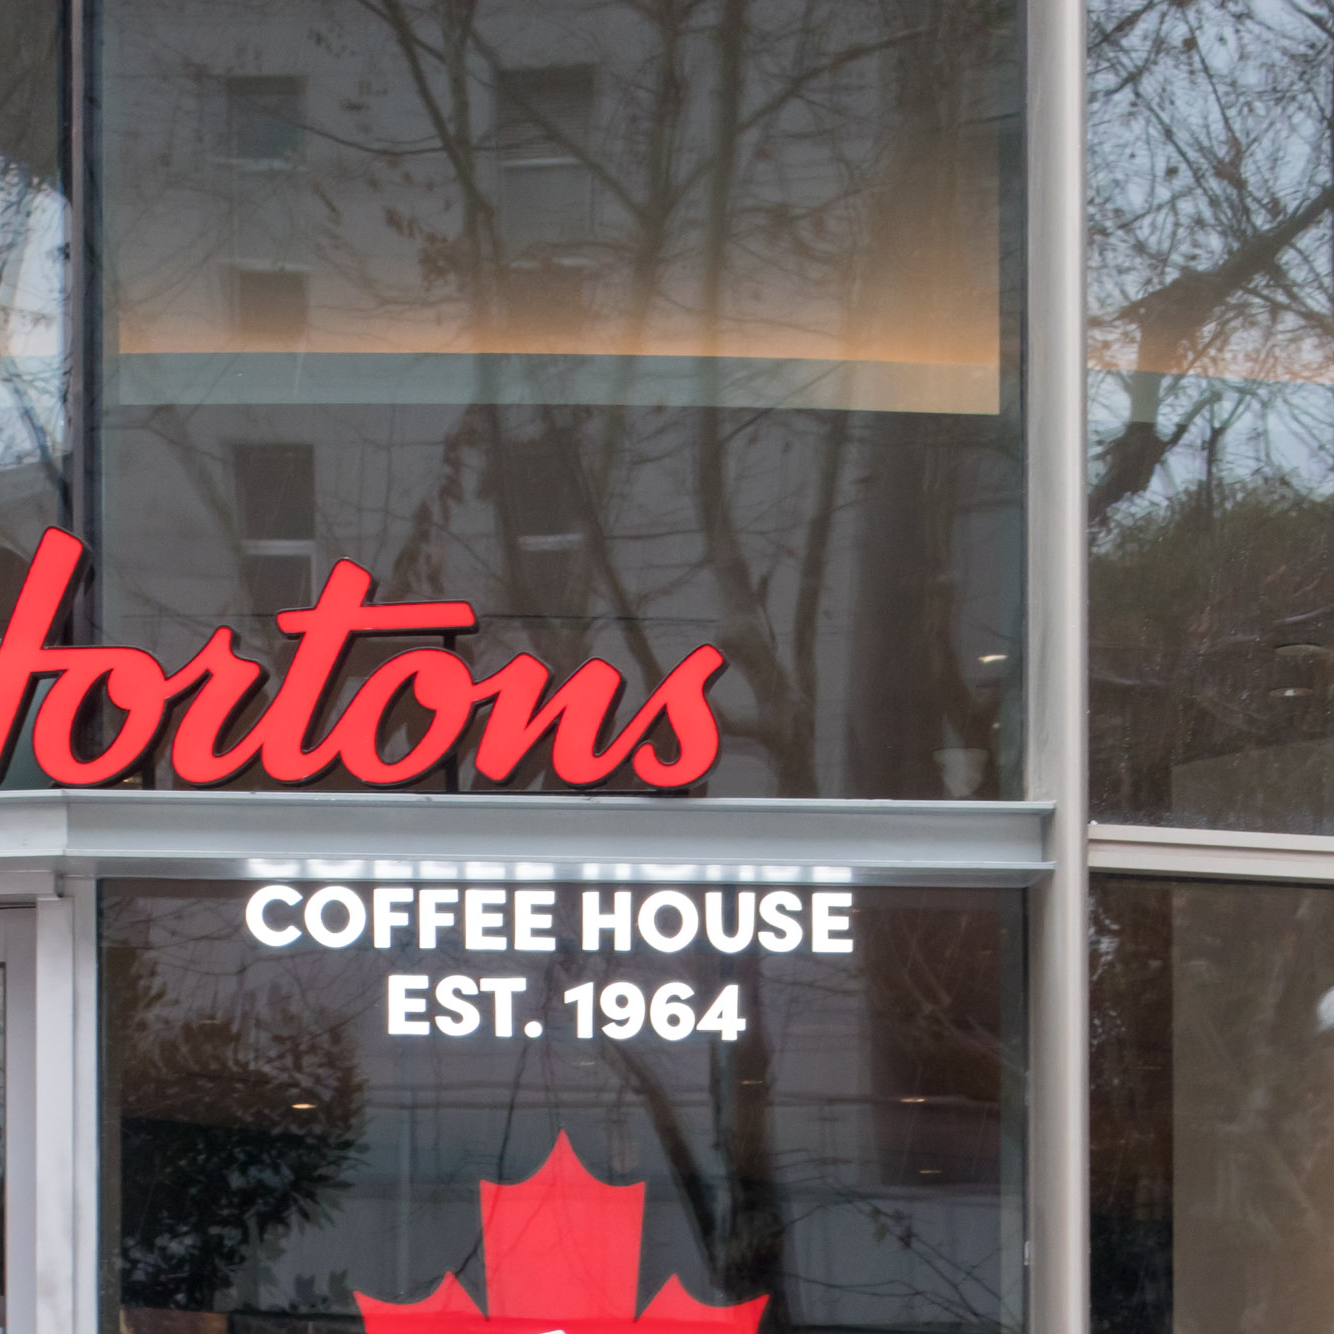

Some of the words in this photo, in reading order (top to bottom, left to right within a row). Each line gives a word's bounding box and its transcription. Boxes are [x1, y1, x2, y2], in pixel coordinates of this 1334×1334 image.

[245, 884, 556, 949] COFFEE
[581, 888, 855, 954] HOUSE
[387, 974, 543, 1038] EST.
[563, 981, 747, 1041] 1964
